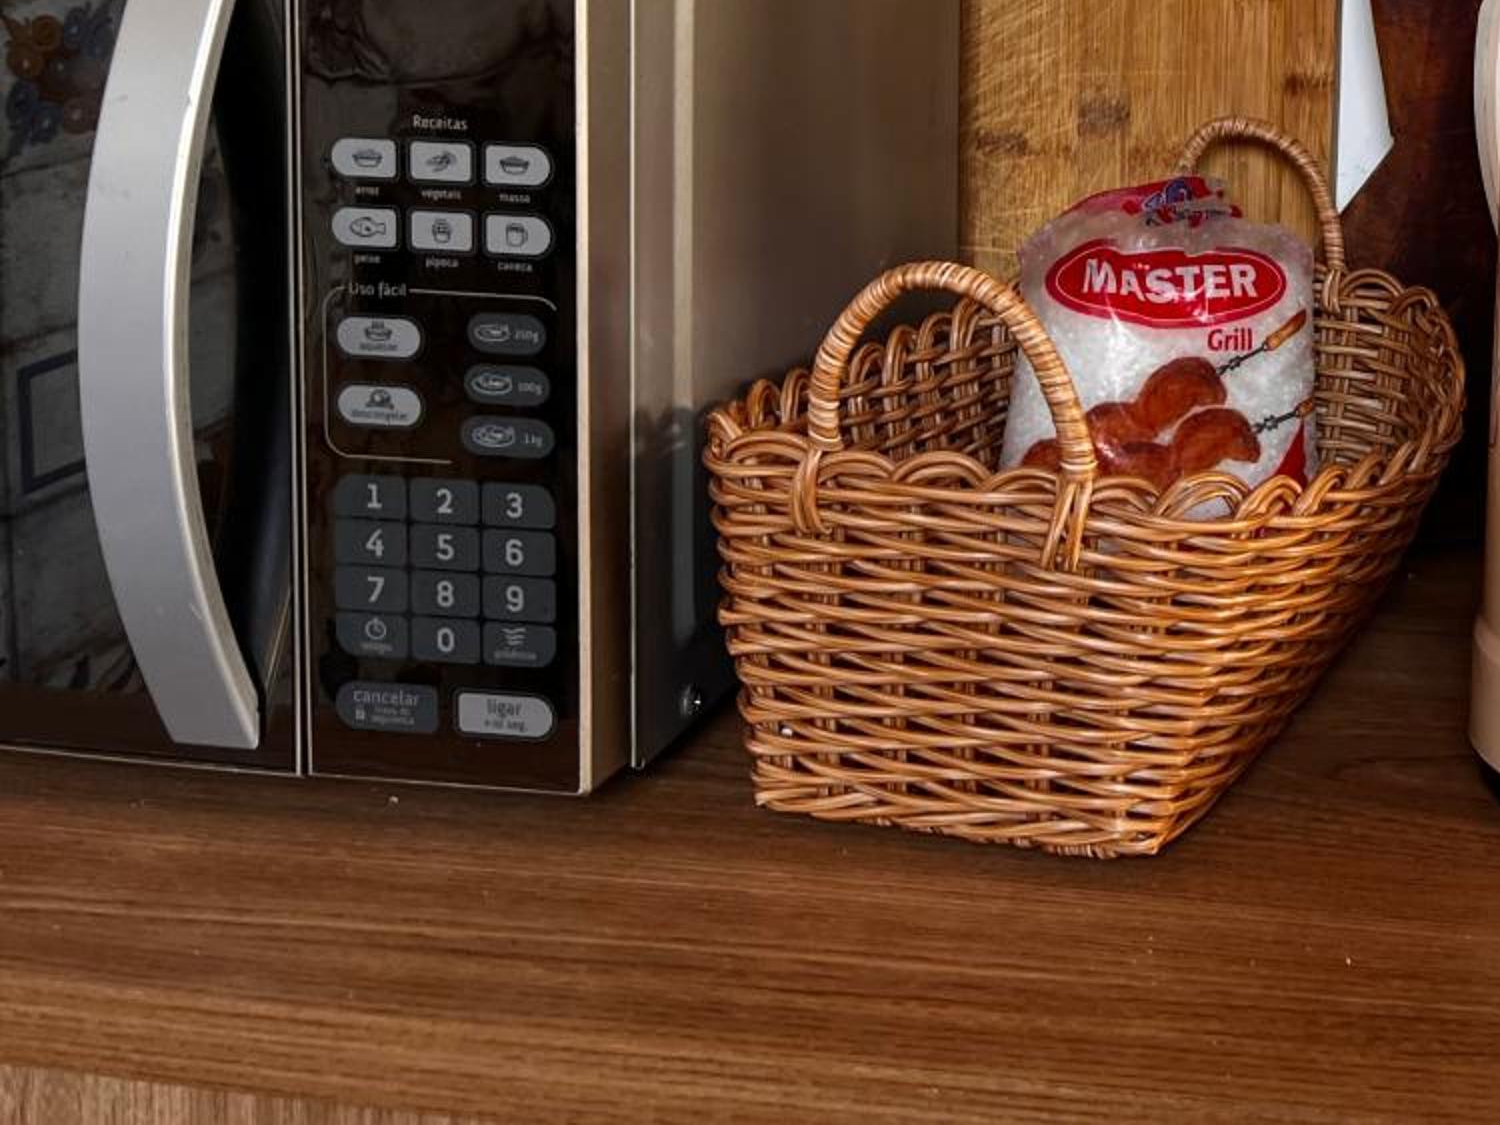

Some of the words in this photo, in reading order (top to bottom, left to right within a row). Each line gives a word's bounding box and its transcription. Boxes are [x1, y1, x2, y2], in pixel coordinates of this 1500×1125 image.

[413, 114, 468, 131] Receitas
[349, 282, 375, 296] Uso
[1083, 257, 1259, 305] MASTER
[1207, 327, 1254, 352] Grill
[367, 484, 382, 509] 1
[436, 488, 453, 514] 2
[506, 492, 523, 518] 3
[366, 529, 384, 557] 4
[437, 534, 454, 560] 5
[505, 539, 524, 565] 6
[367, 576, 384, 603] 7
[437, 580, 454, 607] 8
[505, 585, 524, 612] 9
[437, 627, 454, 653] 0
[353, 689, 419, 706] cancelar
[487, 699, 522, 718] ligar
